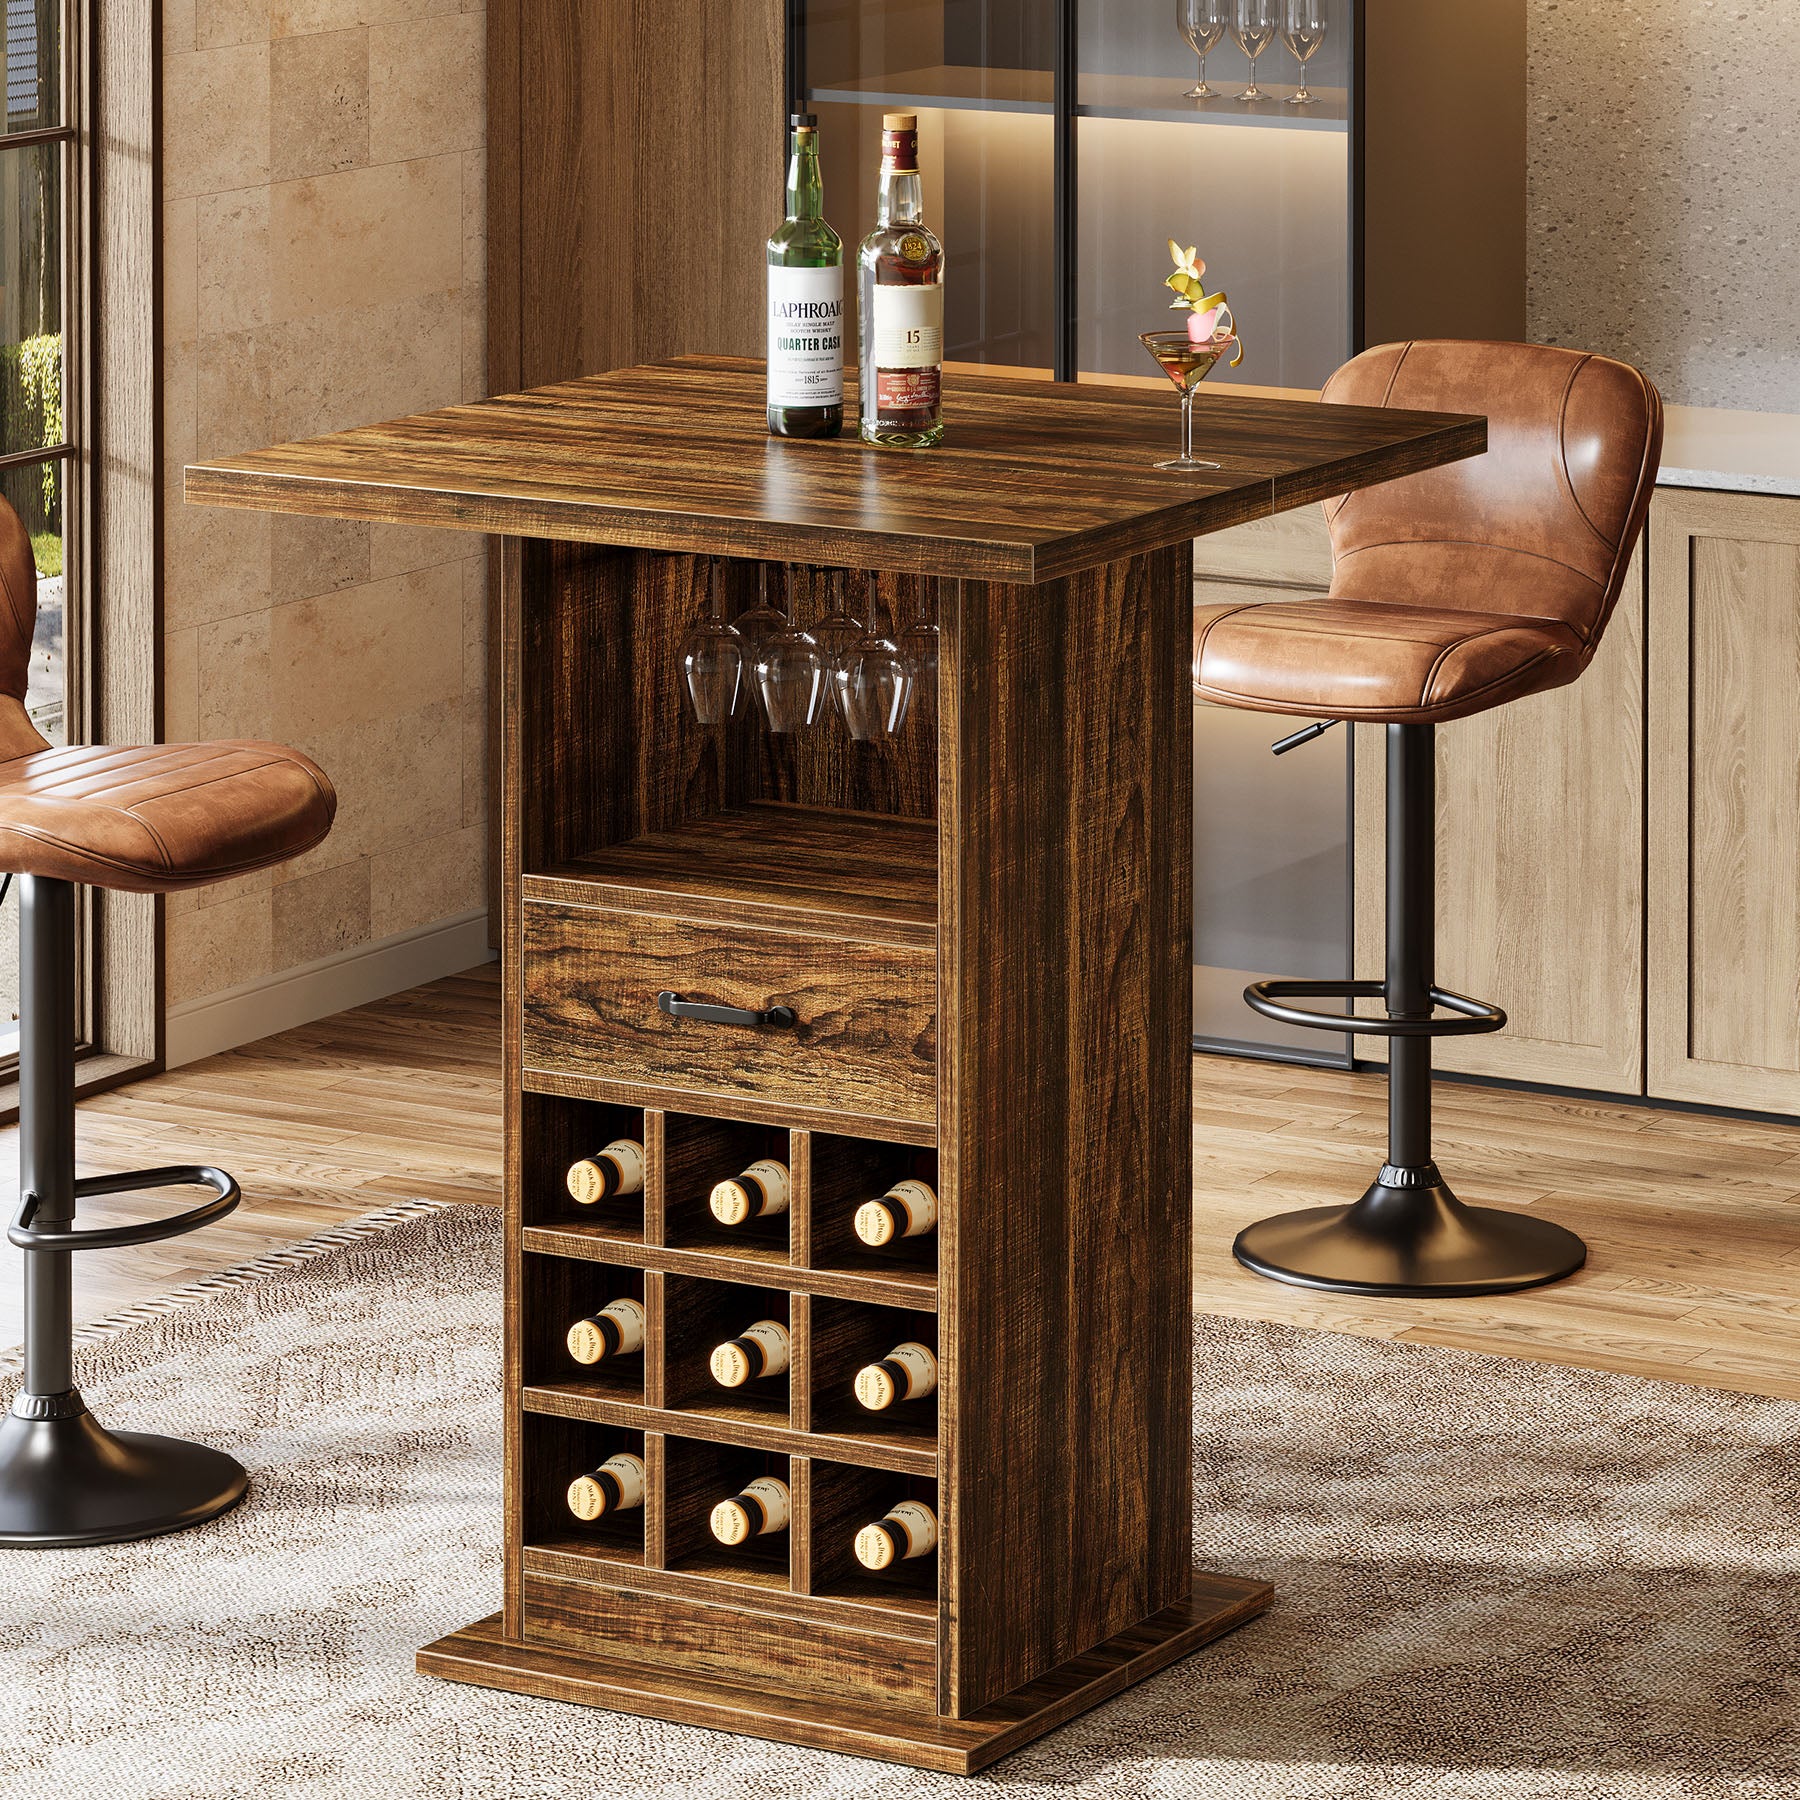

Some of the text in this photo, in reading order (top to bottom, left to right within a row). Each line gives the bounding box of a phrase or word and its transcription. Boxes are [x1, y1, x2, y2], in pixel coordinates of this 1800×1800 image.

[904, 242, 921, 250] 1824
[907, 330, 920, 344] 15
[777, 337, 819, 351] QUARTER
[804, 376, 820, 385] 1815
